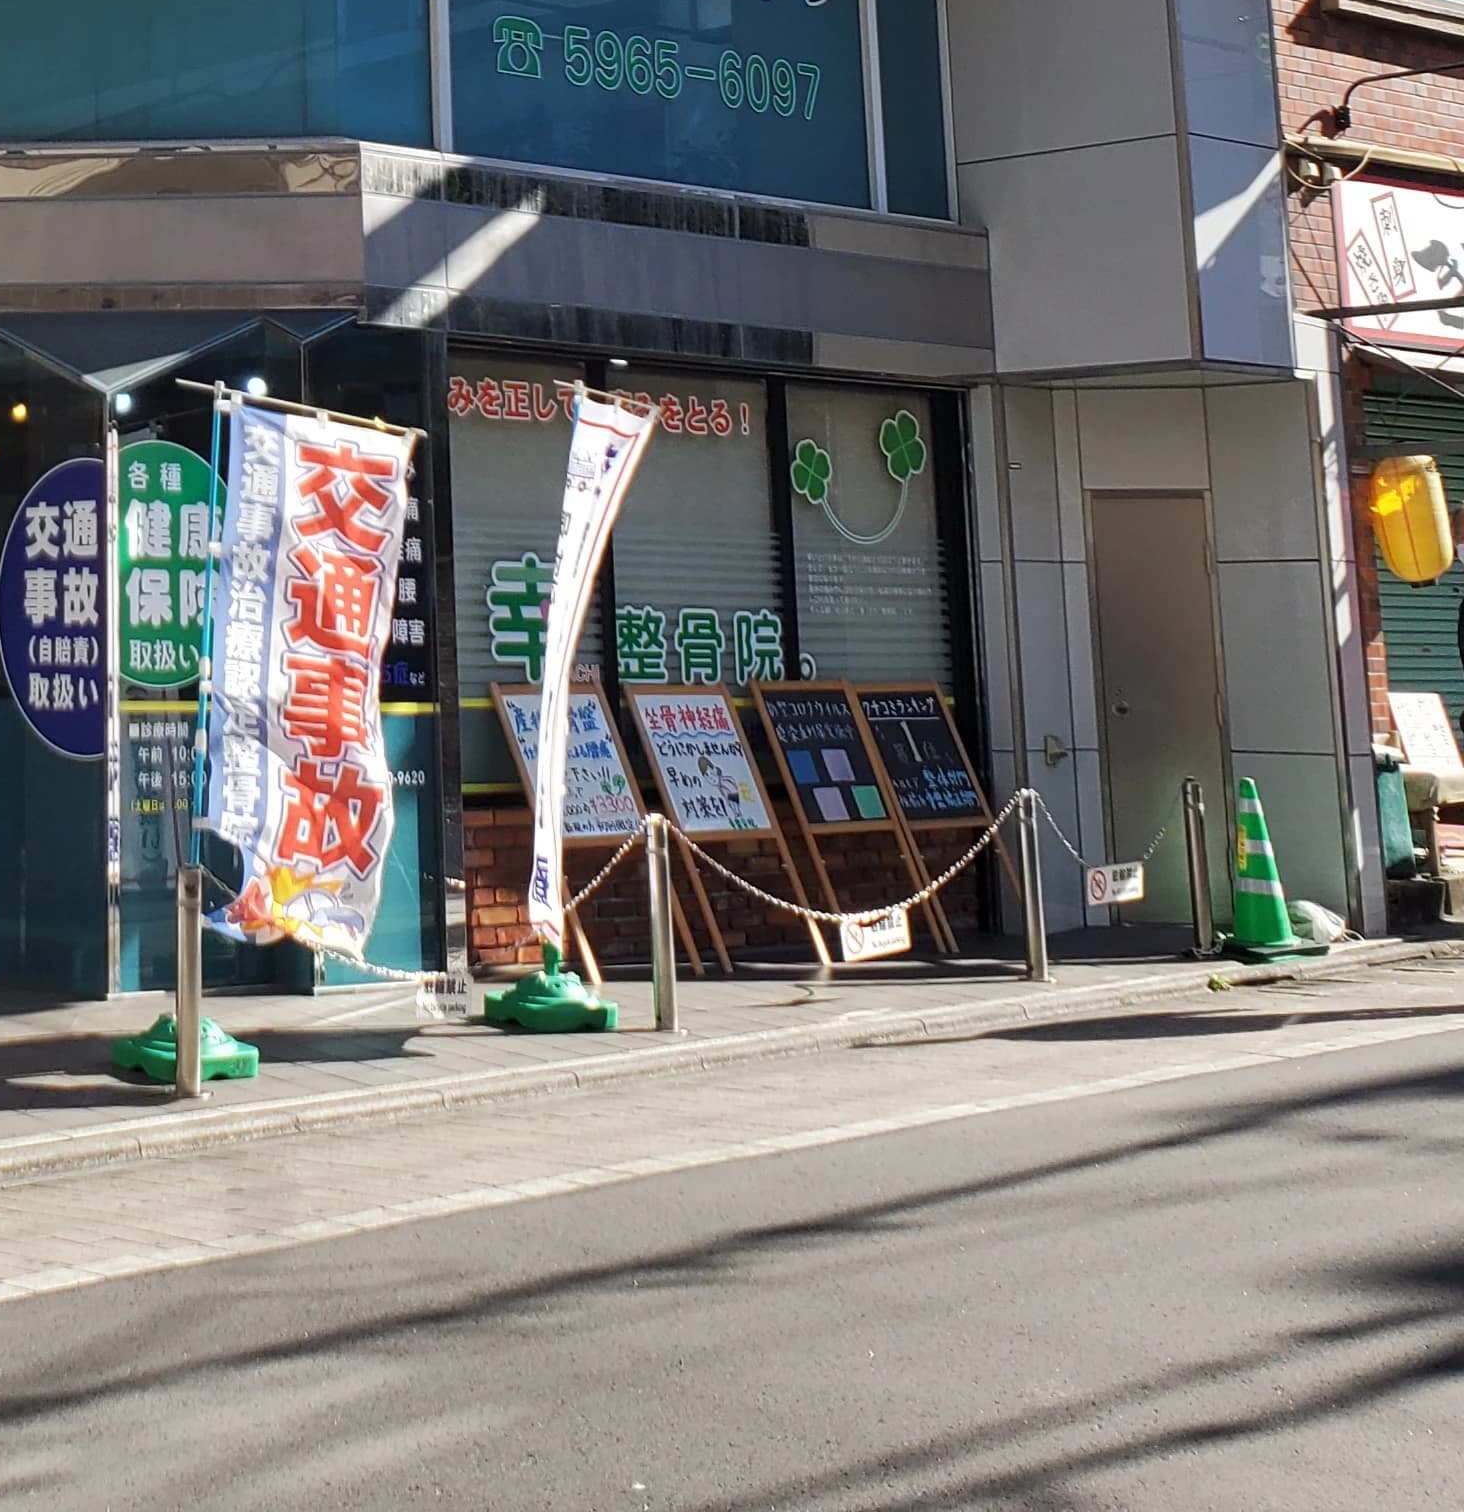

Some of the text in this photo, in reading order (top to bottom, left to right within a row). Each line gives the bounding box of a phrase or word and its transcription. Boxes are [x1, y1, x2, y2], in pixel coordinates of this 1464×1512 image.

[563, 24, 821, 120] 5965-6097
[127, 461, 182, 492] 各種
[24, 499, 99, 560] 交通
[124, 498, 223, 560] 健康
[23, 567, 100, 627] 事故
[124, 567, 219, 628] 保険
[128, 639, 200, 672] 取扱い
[277, 439, 399, 880] 交通事故
[28, 673, 100, 710] 取扱い
[138, 746, 163, 764] 午前
[138, 770, 163, 789] 午後
